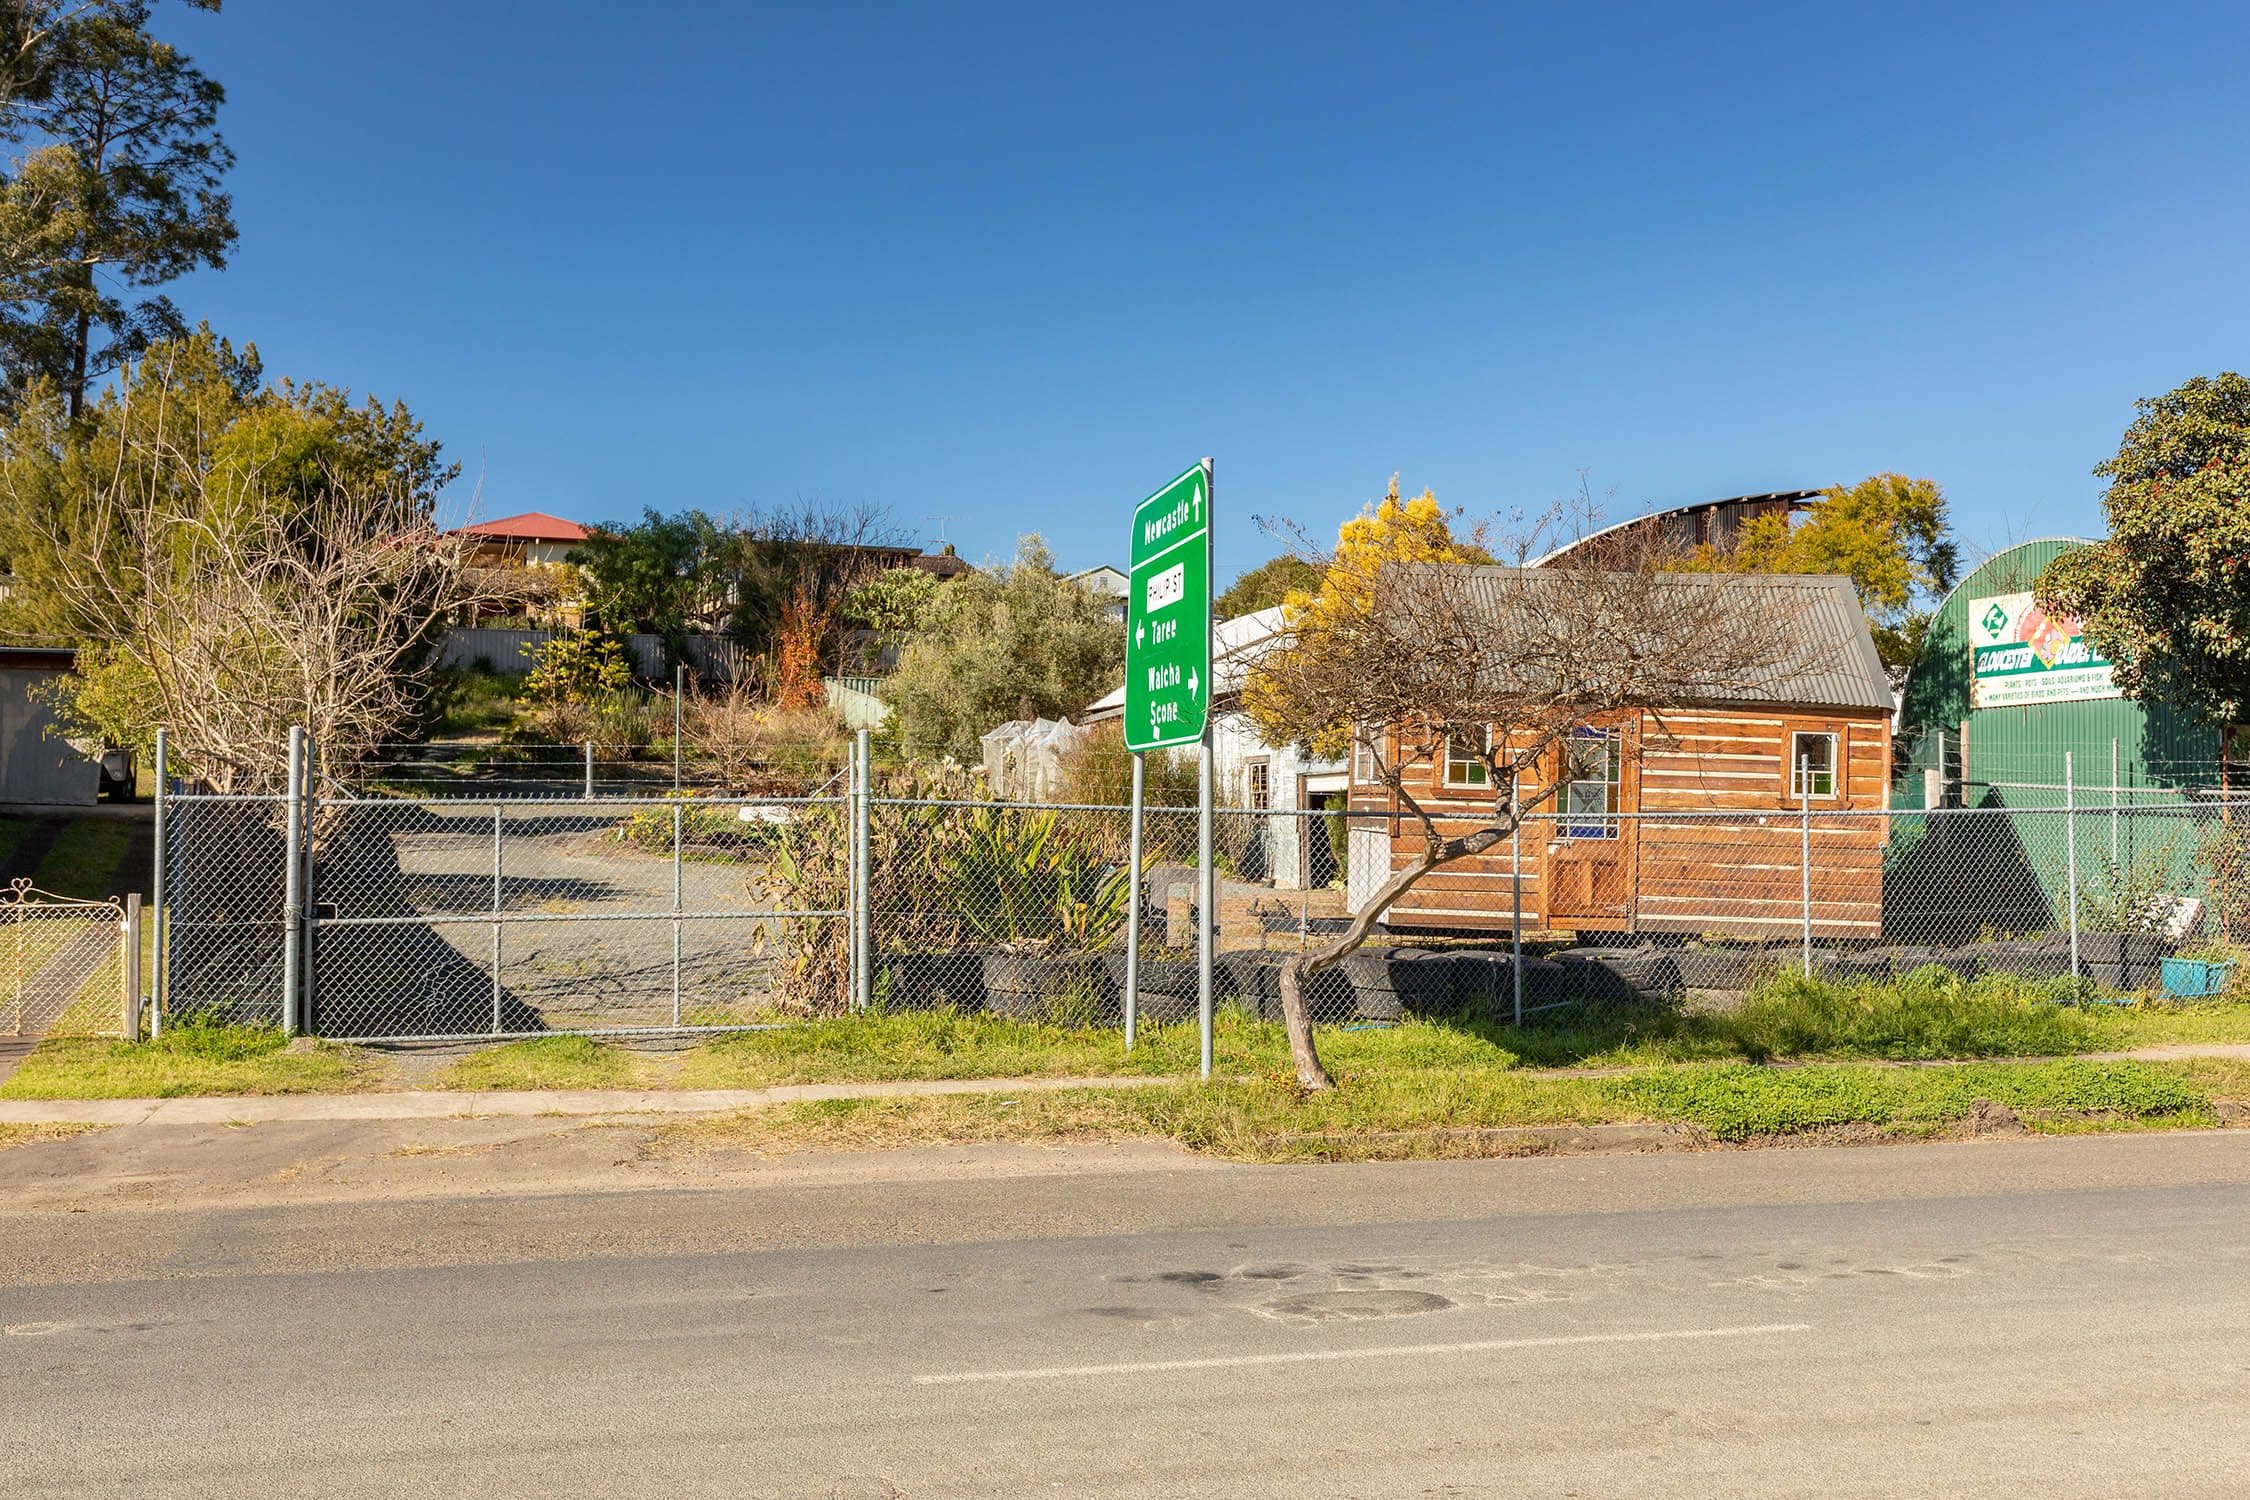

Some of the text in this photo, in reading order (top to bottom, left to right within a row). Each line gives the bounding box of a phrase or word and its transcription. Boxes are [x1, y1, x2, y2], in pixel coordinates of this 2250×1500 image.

[1144, 499, 1189, 546] Newcastle
[1173, 572, 1182, 593] ST
[1152, 619, 1176, 645] Taree
[1148, 662, 1180, 692] Walcha
[1150, 700, 1178, 726] Scone
